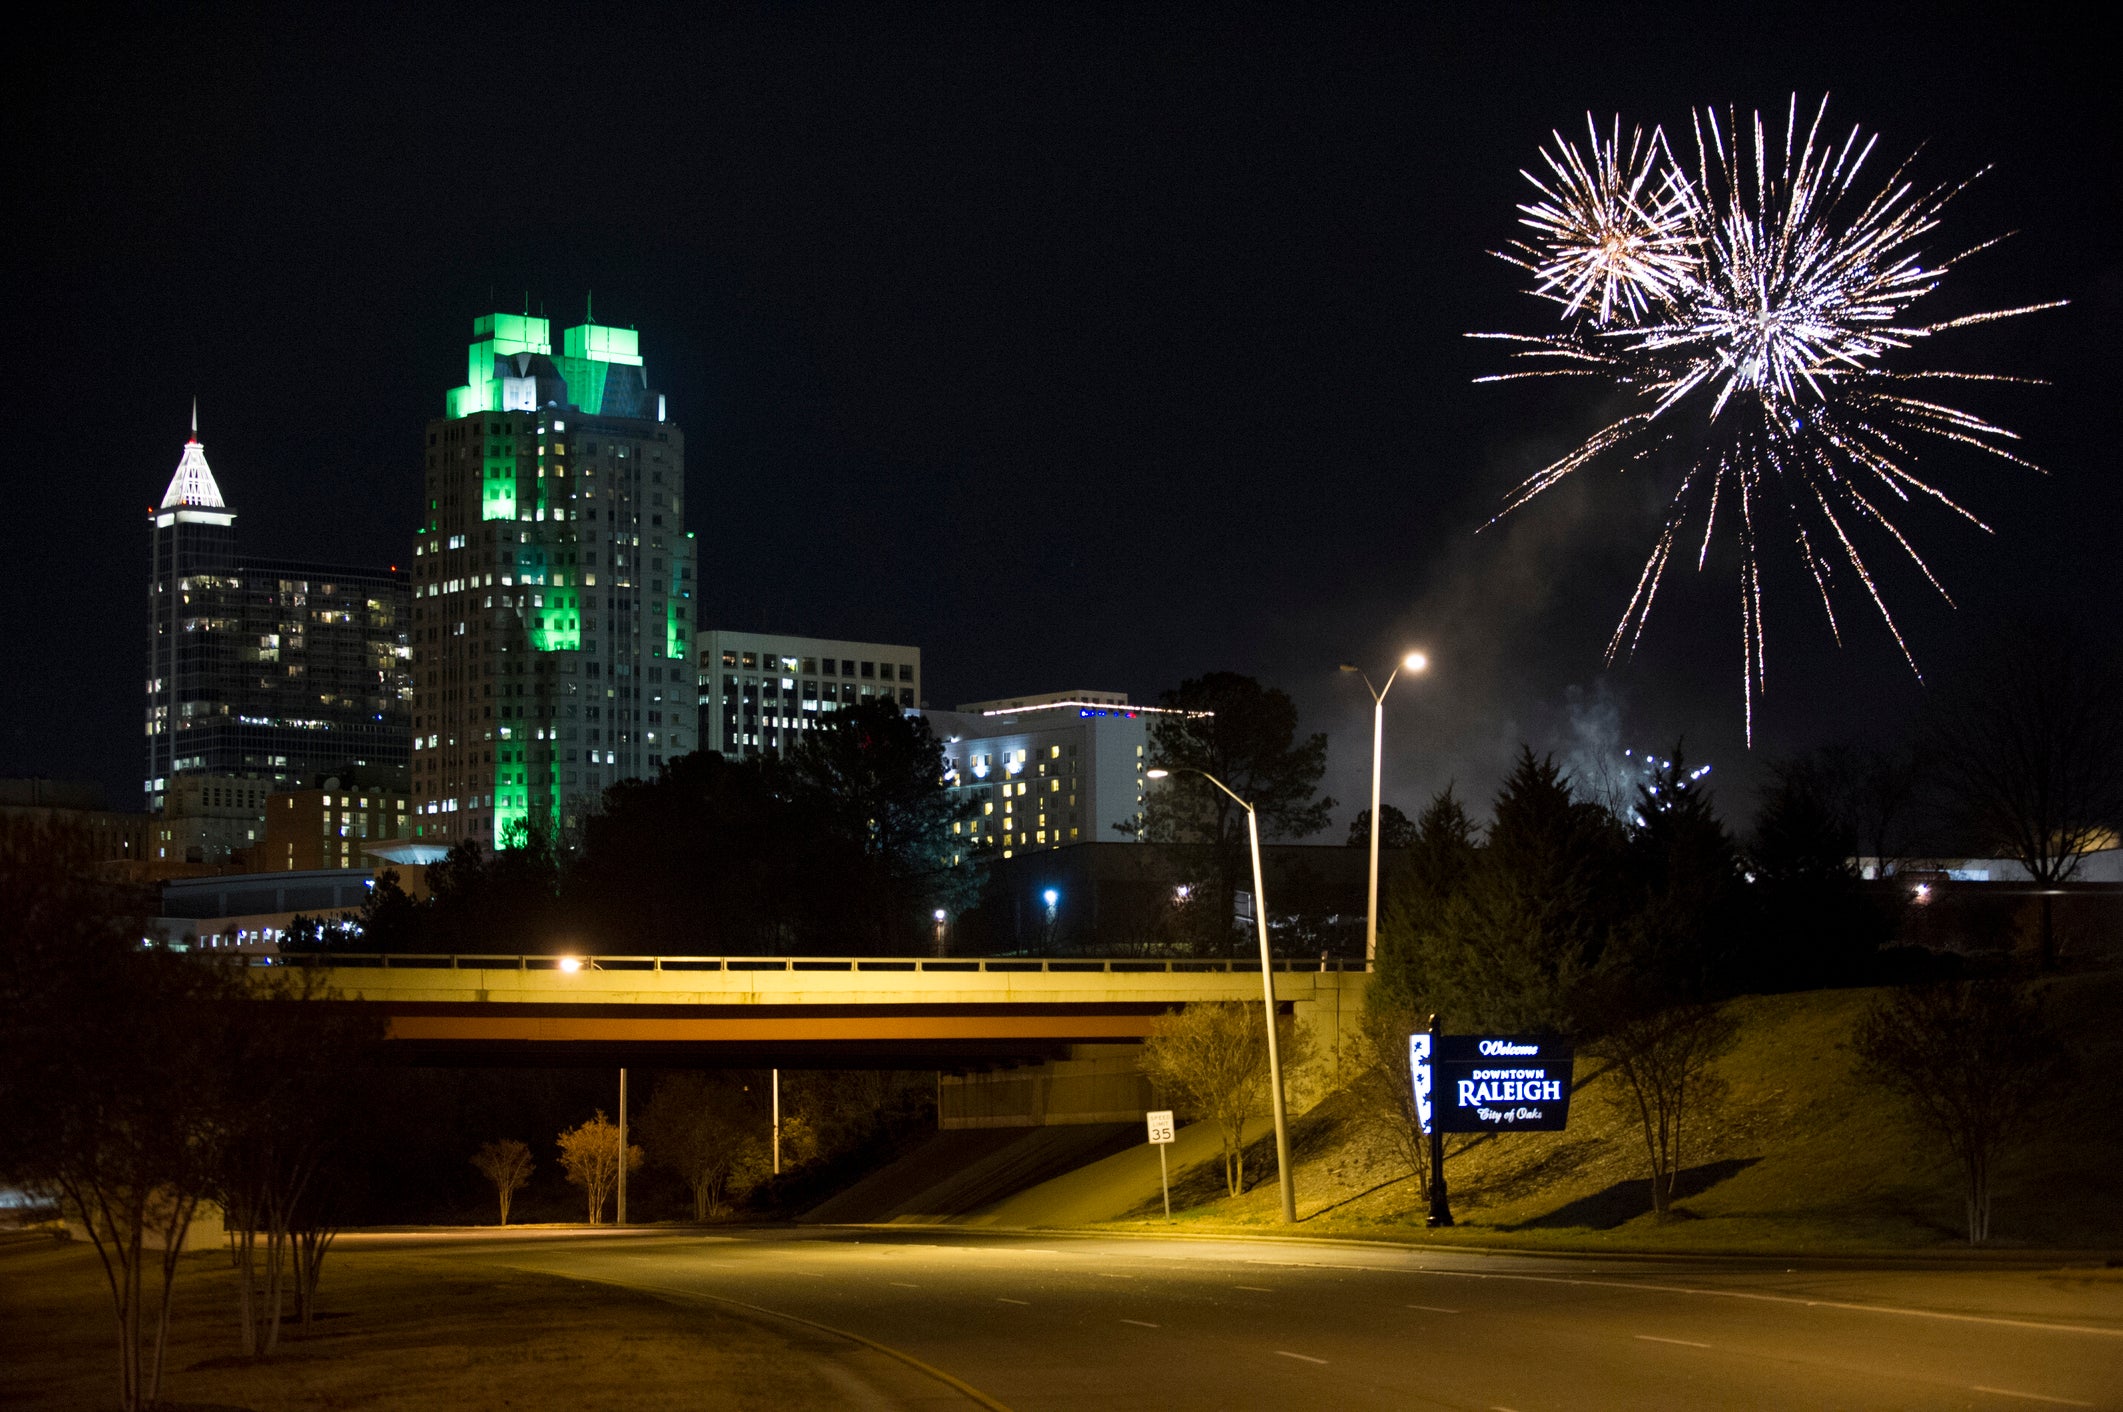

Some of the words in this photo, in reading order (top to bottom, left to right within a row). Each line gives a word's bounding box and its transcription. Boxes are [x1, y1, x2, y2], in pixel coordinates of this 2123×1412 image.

[1479, 1040, 1539, 1055] Welcome
[1473, 1069, 1544, 1079] DOWNTOWN
[1457, 1080, 1561, 1107] RALEIGH
[1477, 1108, 1502, 1123] City
[1503, 1108, 1515, 1123] of
[1516, 1107, 1542, 1120] Oaks
[1152, 1128, 1171, 1141] 35
